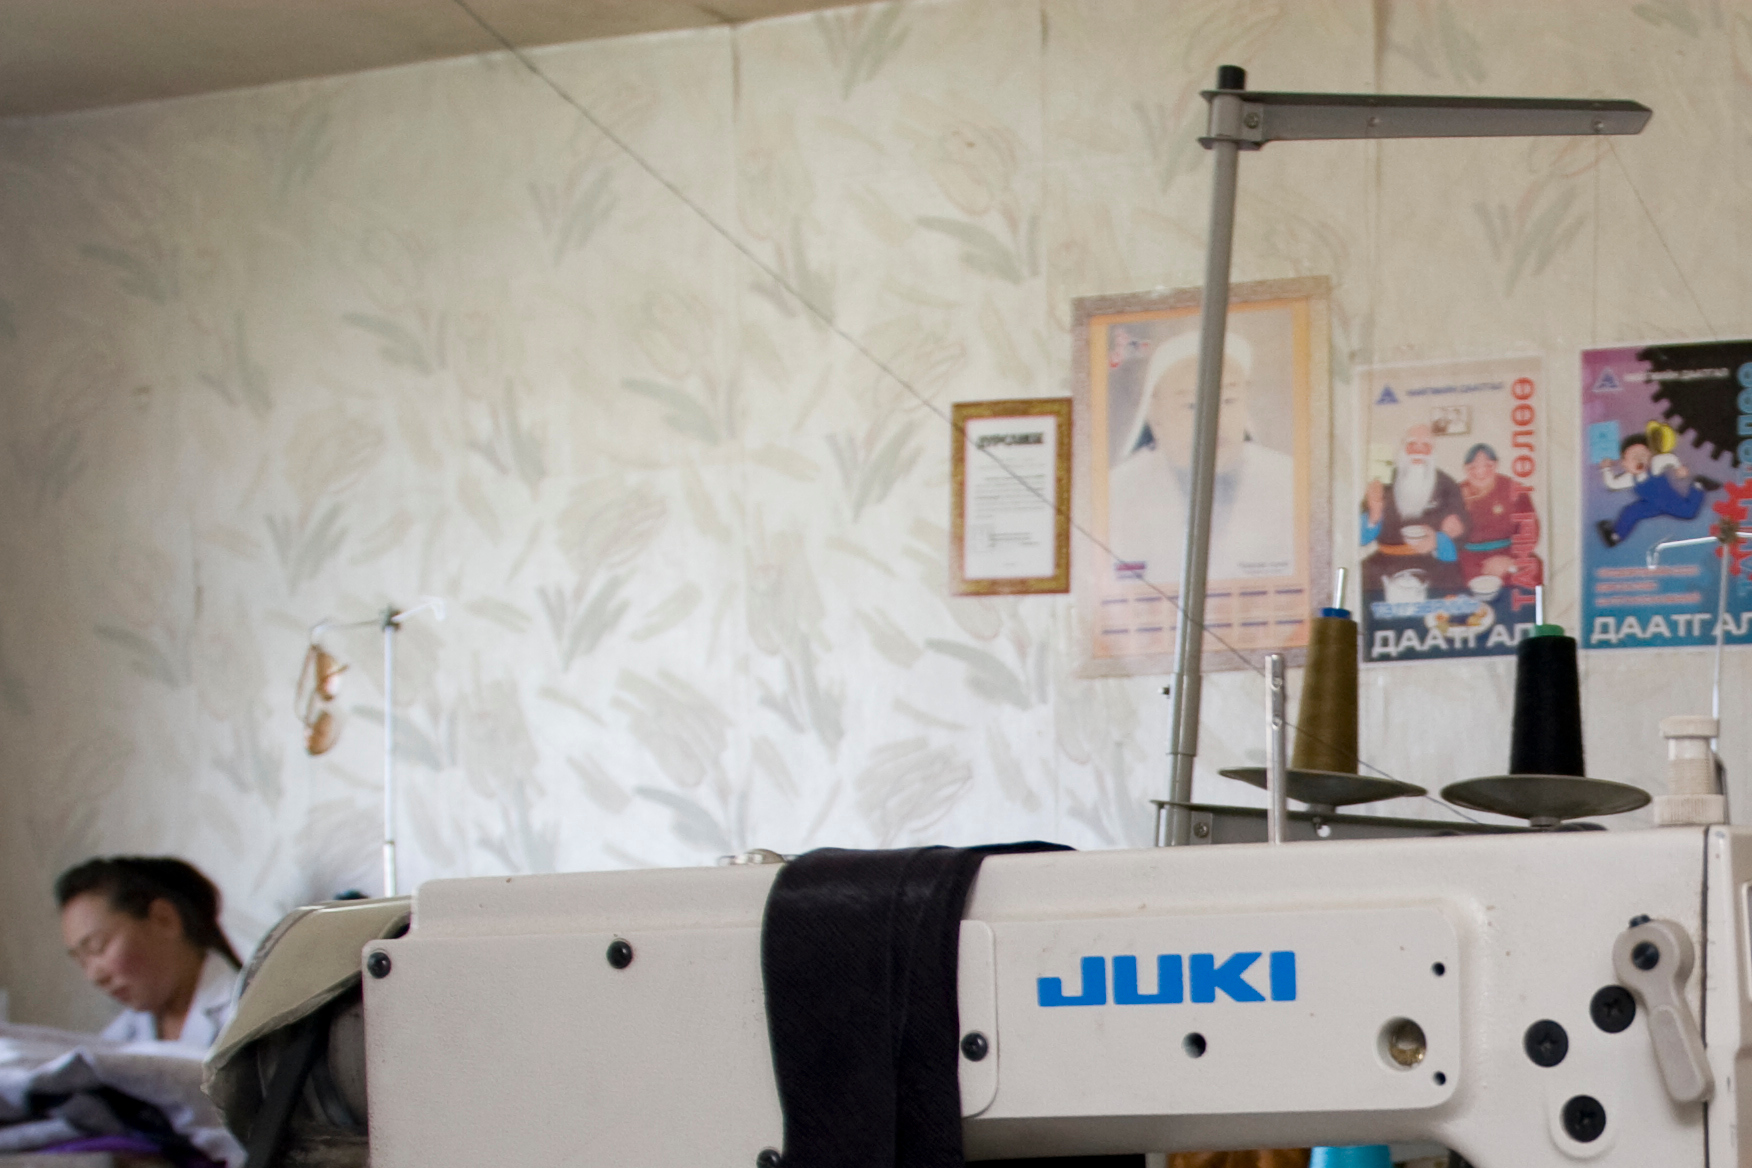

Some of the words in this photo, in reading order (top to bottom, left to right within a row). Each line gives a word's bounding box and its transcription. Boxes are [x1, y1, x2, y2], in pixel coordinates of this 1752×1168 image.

[1510, 377, 1536, 501] ТӨЛӨӨ
[1510, 512, 1537, 611] ТАНЫ
[1036, 950, 1297, 1007] JUKI
